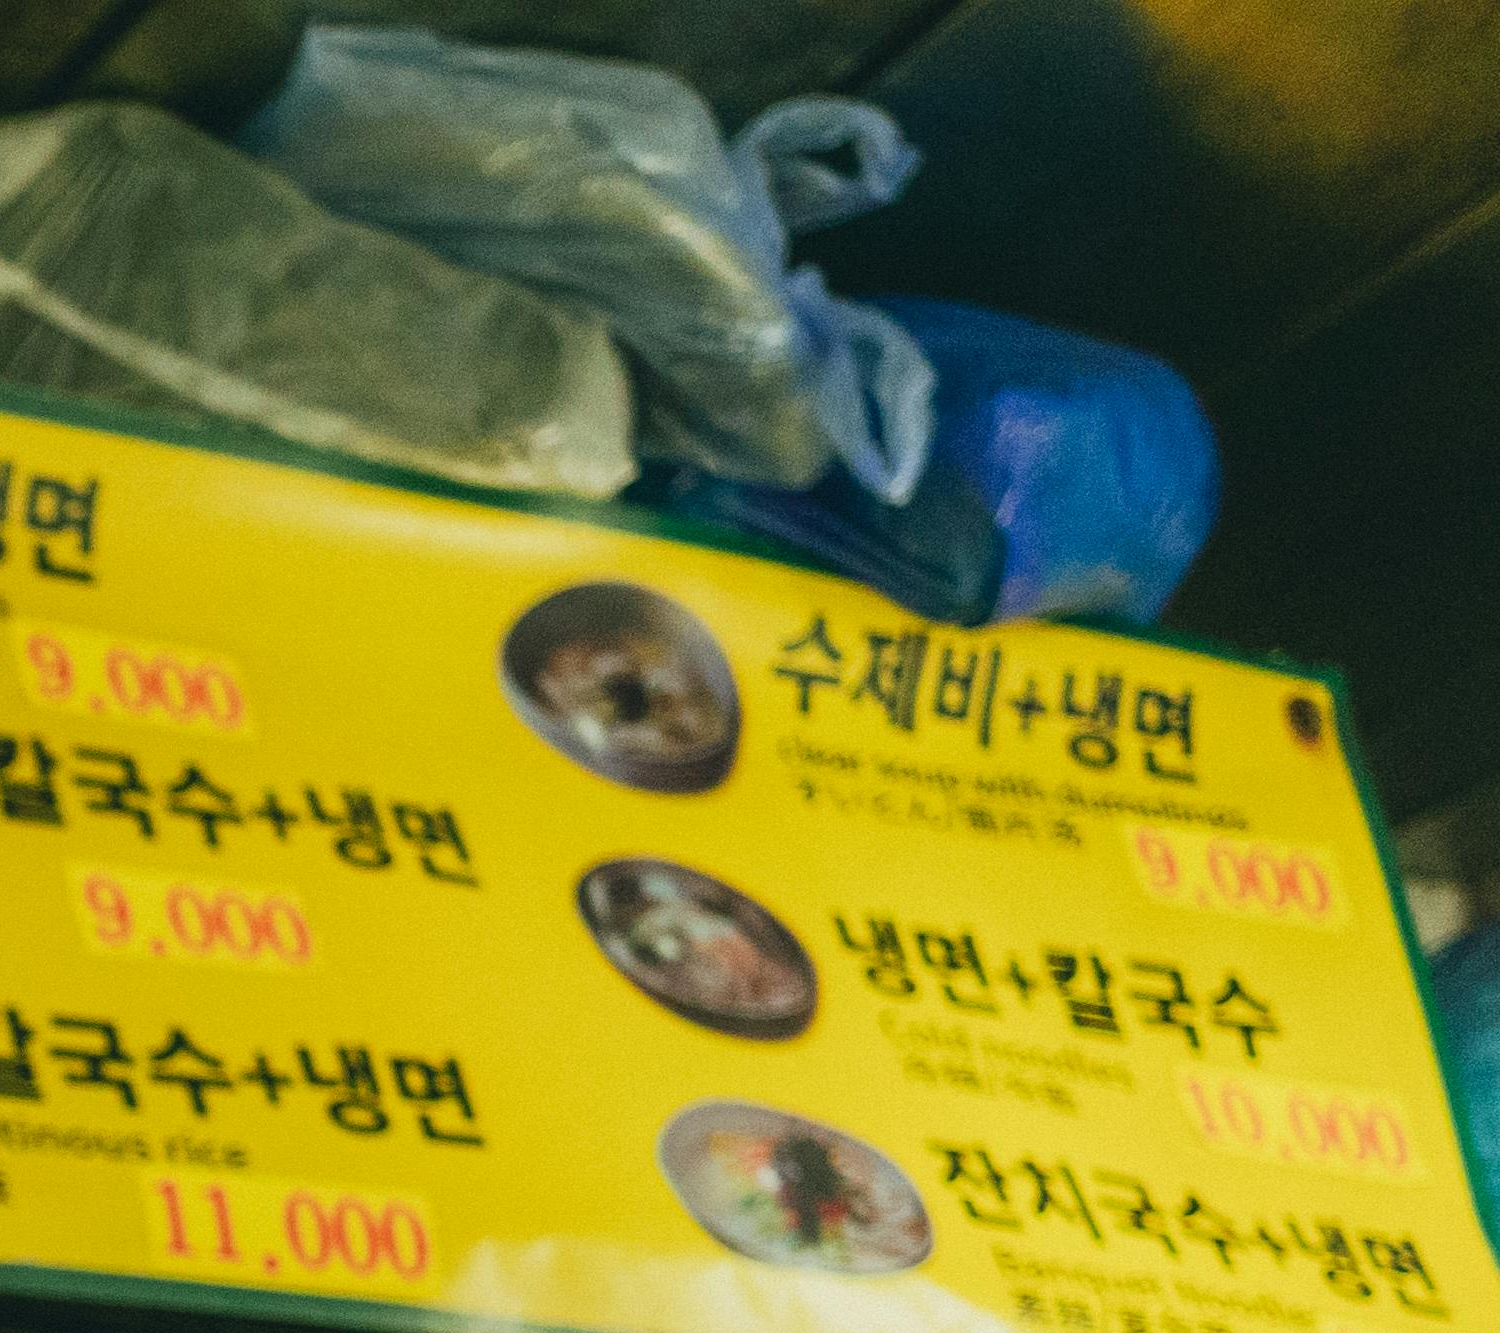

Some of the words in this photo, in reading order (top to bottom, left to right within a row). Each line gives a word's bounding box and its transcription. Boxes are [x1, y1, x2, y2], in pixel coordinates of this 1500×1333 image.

[769, 612, 1201, 784] 수제비+냉면
[834, 911, 1284, 1063] 냉면+칼국수
[927, 1136, 1454, 1324] 잔치국수+냉면
